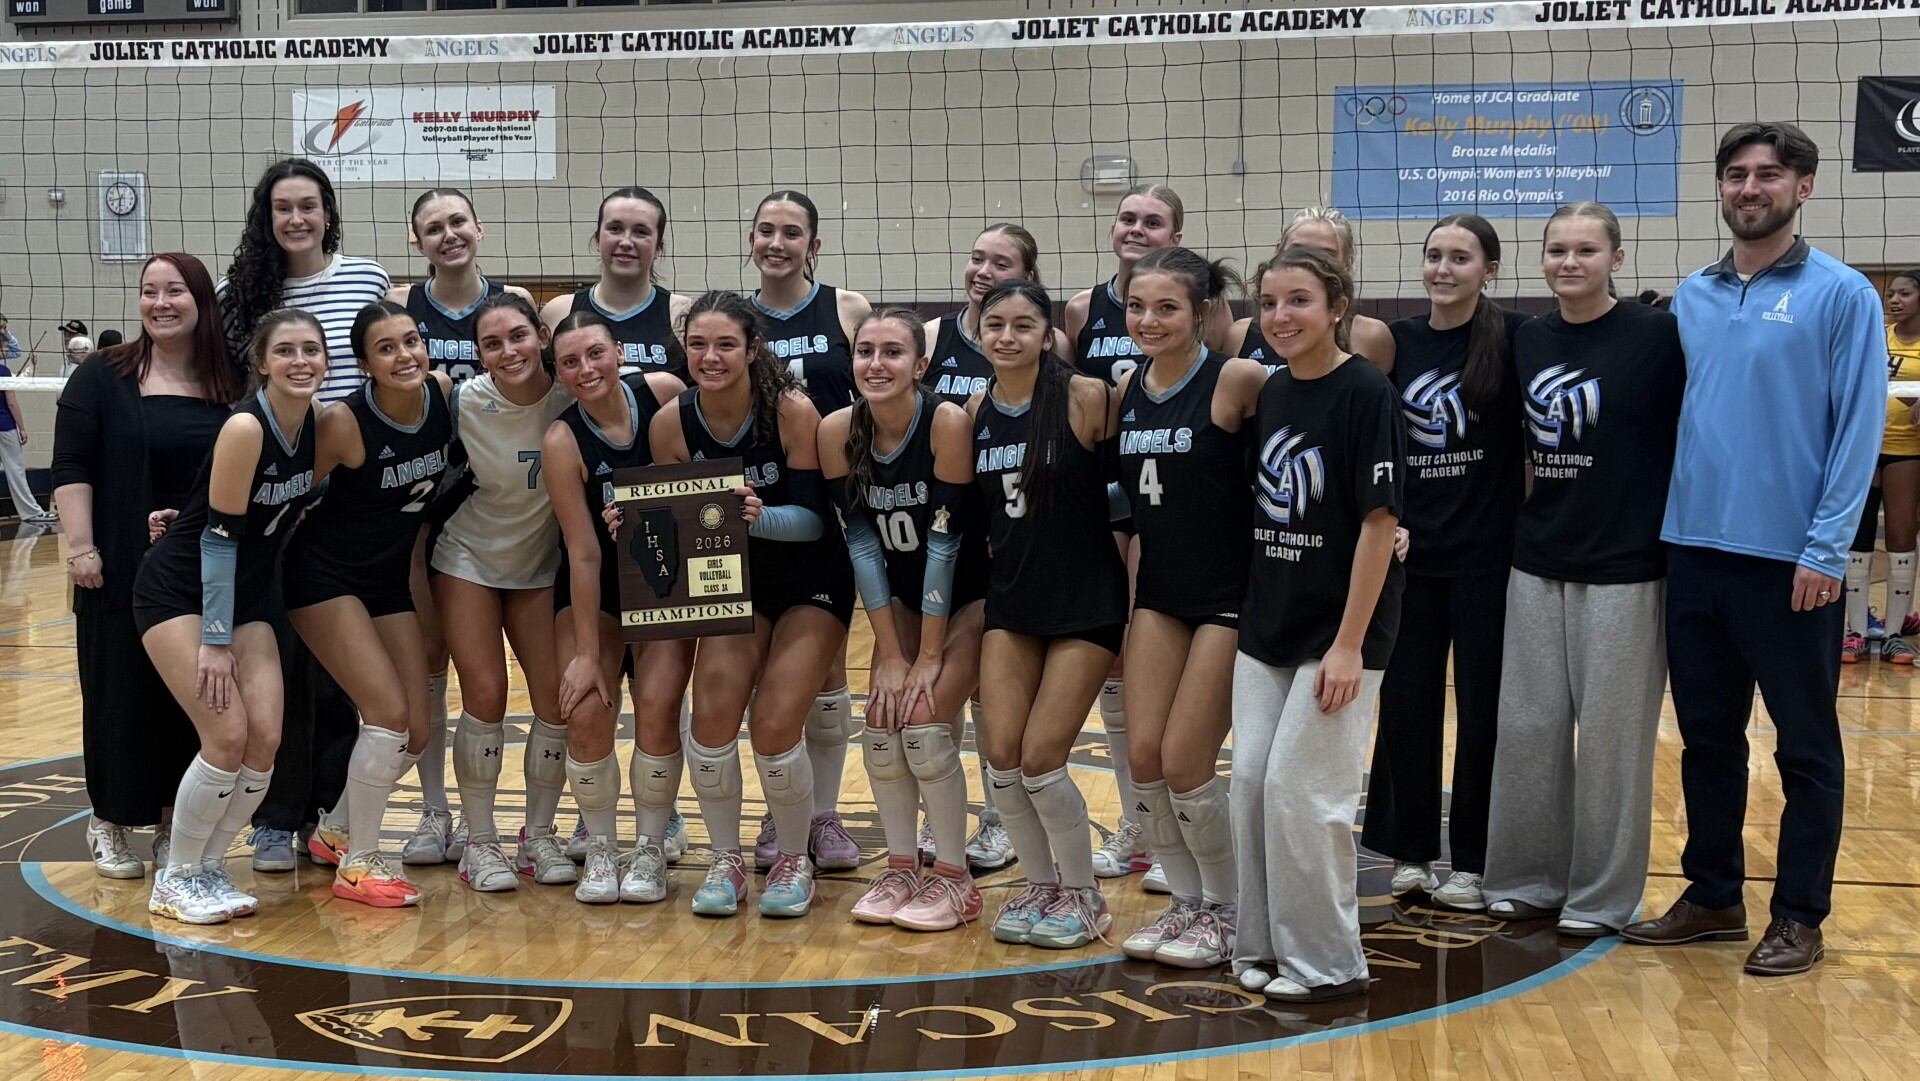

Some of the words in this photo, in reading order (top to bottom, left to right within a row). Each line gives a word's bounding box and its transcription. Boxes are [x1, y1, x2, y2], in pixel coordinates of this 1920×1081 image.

[16, 1, 40, 12] won
[99, 0, 132, 13] game
[193, 0, 218, 8] won
[1535, 0, 1631, 23] JOLIET
[1640, 0, 1775, 20] CATHOLIC
[1012, 18, 1099, 41] JOLIET
[1108, 13, 1232, 37] CATHOLIC
[1240, 8, 1366, 32] ACADEMY
[1406, 6, 1495, 28] ANGELS
[533, 34, 614, 55] JOLIET
[621, 30, 734, 52] CATHOLIC
[741, 26, 856, 49] ACADEMY
[893, 25, 975, 48] ANGELS
[0, 47, 57, 63] NGELS
[90, 41, 164, 61] JOLIET
[172, 40, 277, 60] CATHOLIC
[284, 38, 390, 59] ACADEMY
[424, 38, 500, 58] ANGELS
[1432, 93, 1472, 104] Home
[1474, 91, 1486, 103] of
[1487, 91, 1513, 104] JCA
[1517, 91, 1580, 103] Graduate
[413, 111, 461, 123] KELLY
[470, 110, 540, 123] MURPHY
[497, 124, 531, 132] National
[1404, 115, 1458, 140] Kelly
[422, 135, 462, 143] Volleyball
[464, 135, 489, 143] Player
[1452, 145, 1498, 158] Bronze
[1500, 144, 1559, 157] Medalist
[1399, 169, 1423, 180] U.S.
[1427, 168, 1481, 183] Olympic
[1546, 165, 1612, 181] Volleyball
[1442, 190, 1476, 202] 2016
[1479, 189, 1500, 202] Rio
[1503, 188, 1564, 204] Olympics
[624, 343, 668, 365] ELS
[1086, 336, 1144, 359] ANGE
[380, 443, 449, 489] ANGEL
[1433, 448, 1484, 465] CATHOLIC
[518, 450, 542, 490] 7
[1373, 461, 1394, 486] FT
[1419, 464, 1467, 480] ACADEMY
[629, 478, 730, 498] REGIONAL
[1139, 458, 1164, 506] 4
[400, 479, 435, 512] 2
[863, 480, 929, 511] NGELS
[1001, 471, 1028, 519] 5
[876, 510, 920, 552] 10
[1254, 527, 1276, 542] OLIET
[695, 535, 731, 550] 2026
[707, 558, 723, 569] GIRLS
[699, 570, 732, 581] VOLLEYBALL
[703, 584, 719, 593] CLASS
[629, 603, 745, 624] CHAMPIONS
